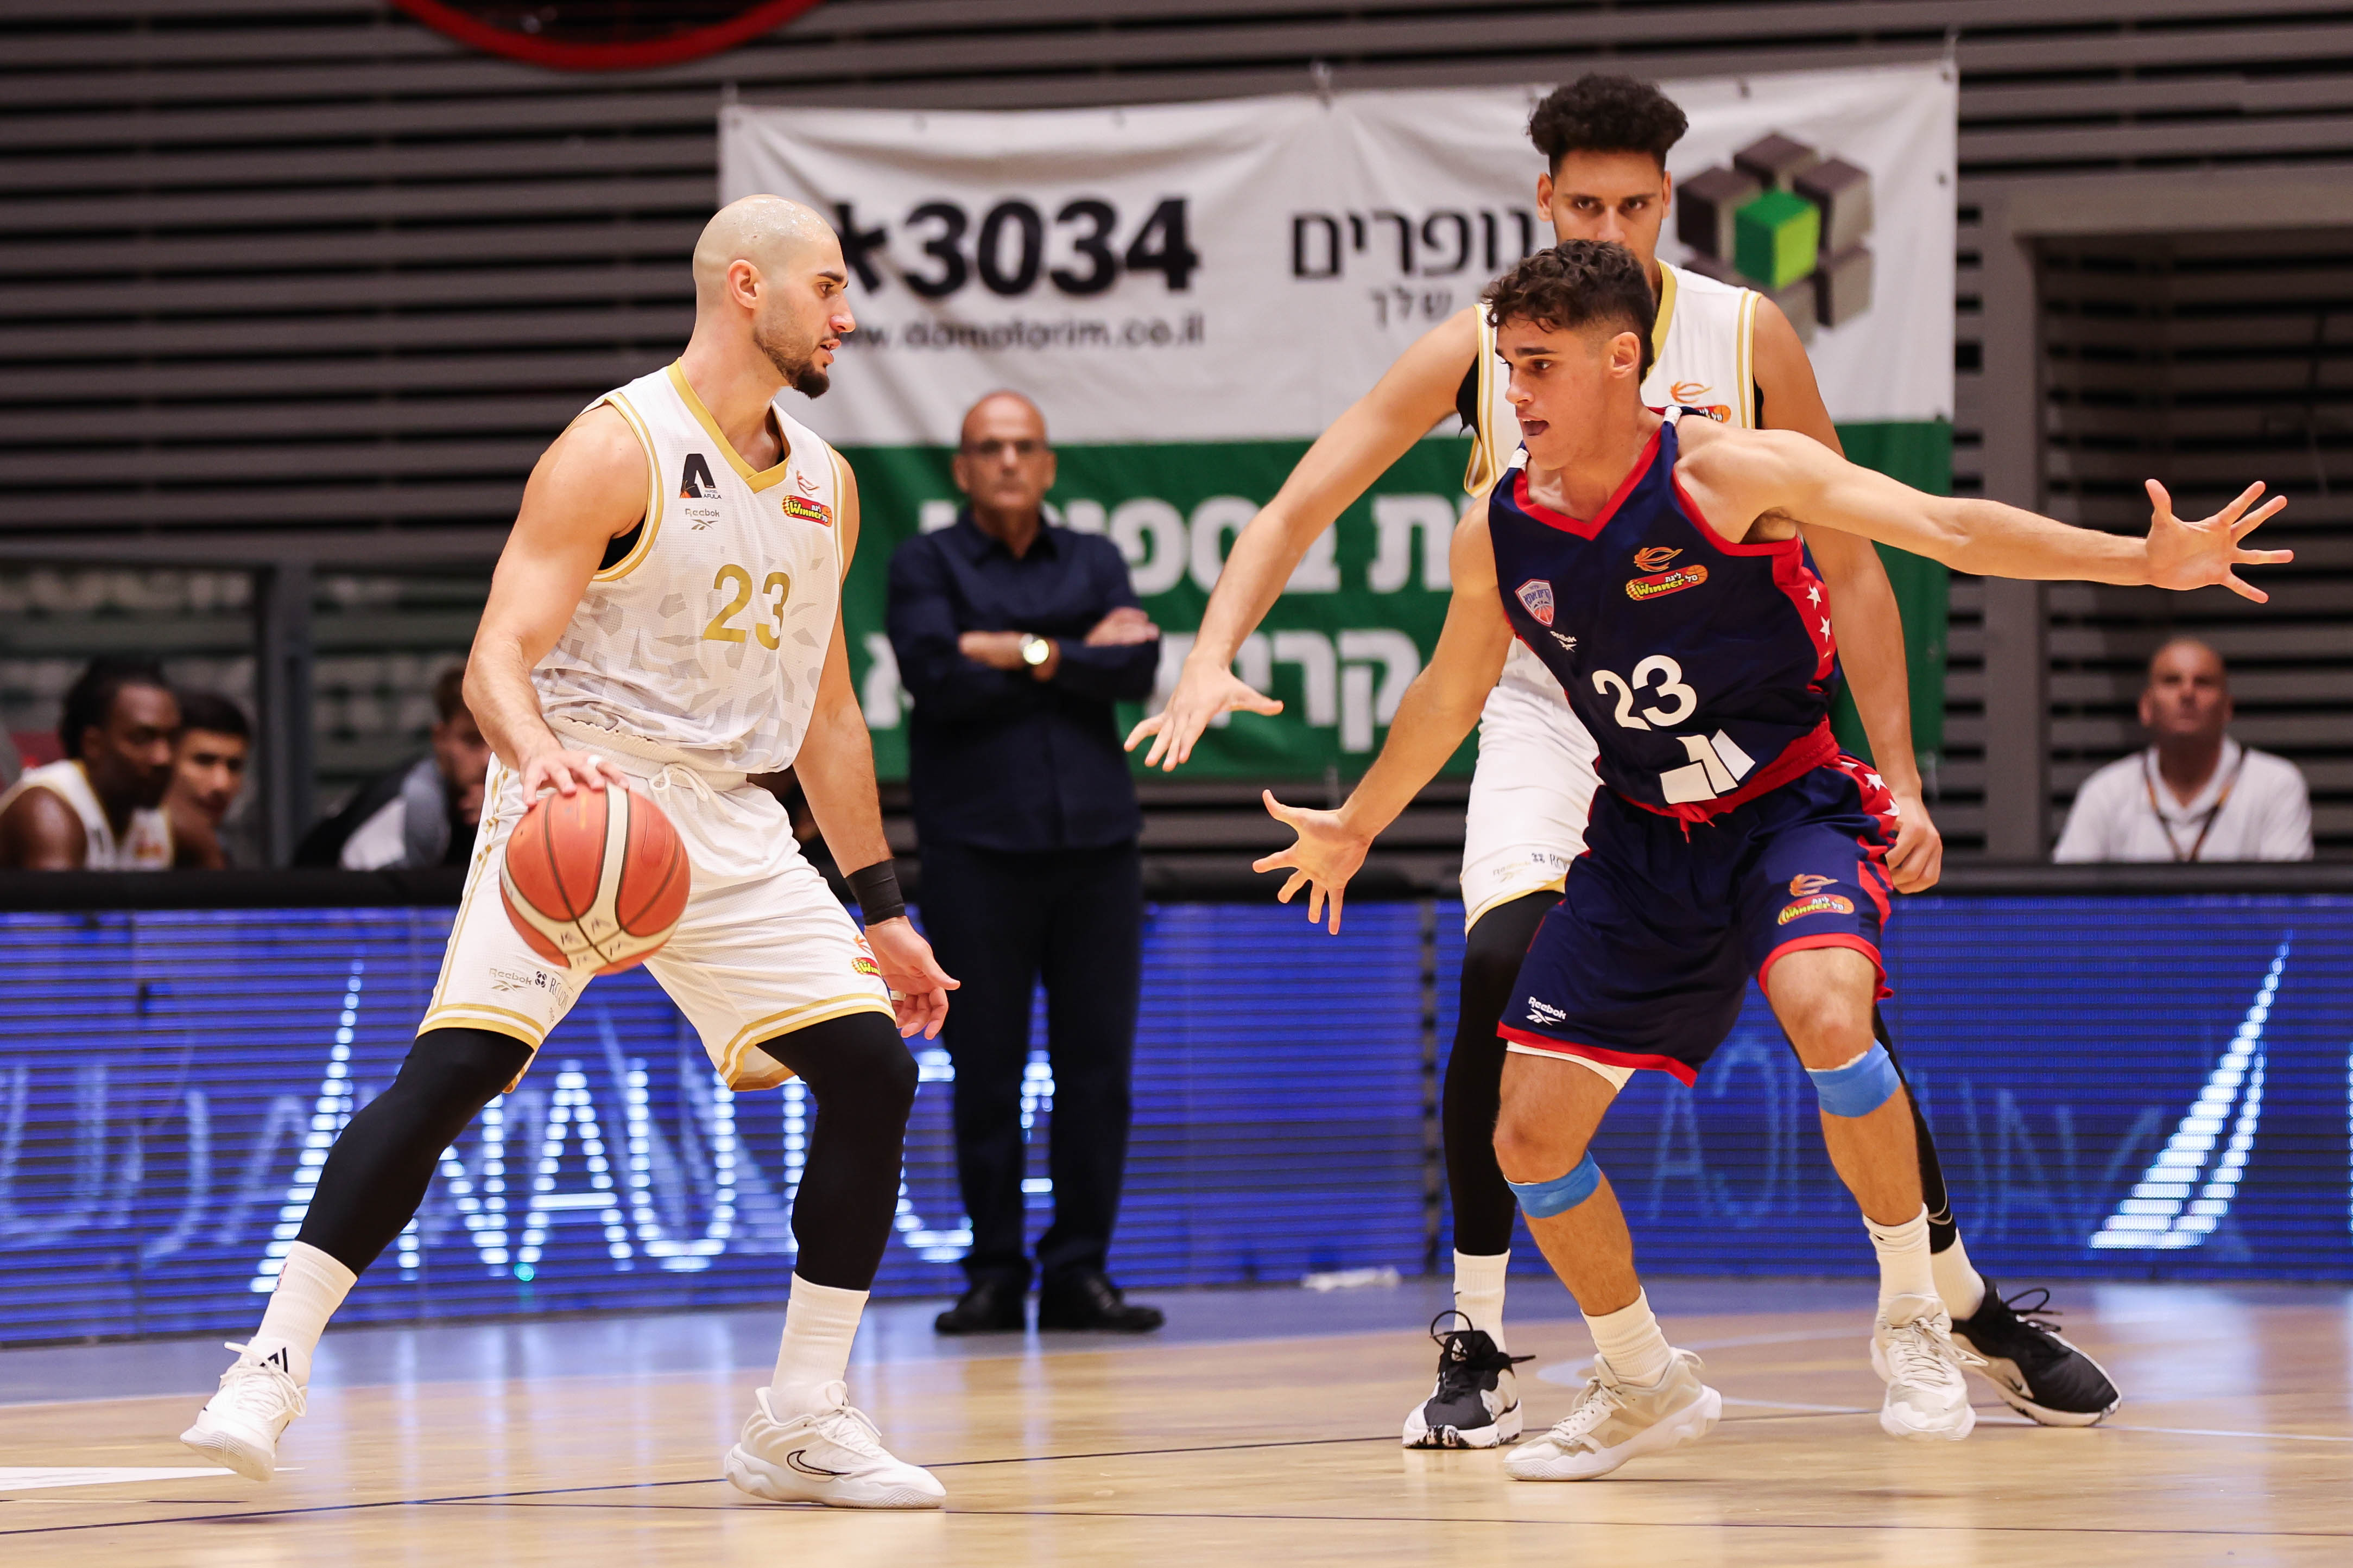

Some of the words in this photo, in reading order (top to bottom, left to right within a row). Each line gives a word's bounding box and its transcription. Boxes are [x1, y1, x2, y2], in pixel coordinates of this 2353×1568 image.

[685, 508, 720, 517] Reebok
[789, 501, 821, 519] Winner
[1665, 572, 1681, 582] ליגת
[1685, 574, 1698, 582] סל
[1635, 579, 1685, 595] Winner
[703, 563, 790, 650] 23
[1592, 655, 1697, 731] 23
[1786, 903, 1830, 919] Winner
[489, 968, 532, 986] Reebok
[1528, 996, 1566, 1020] Reebok
